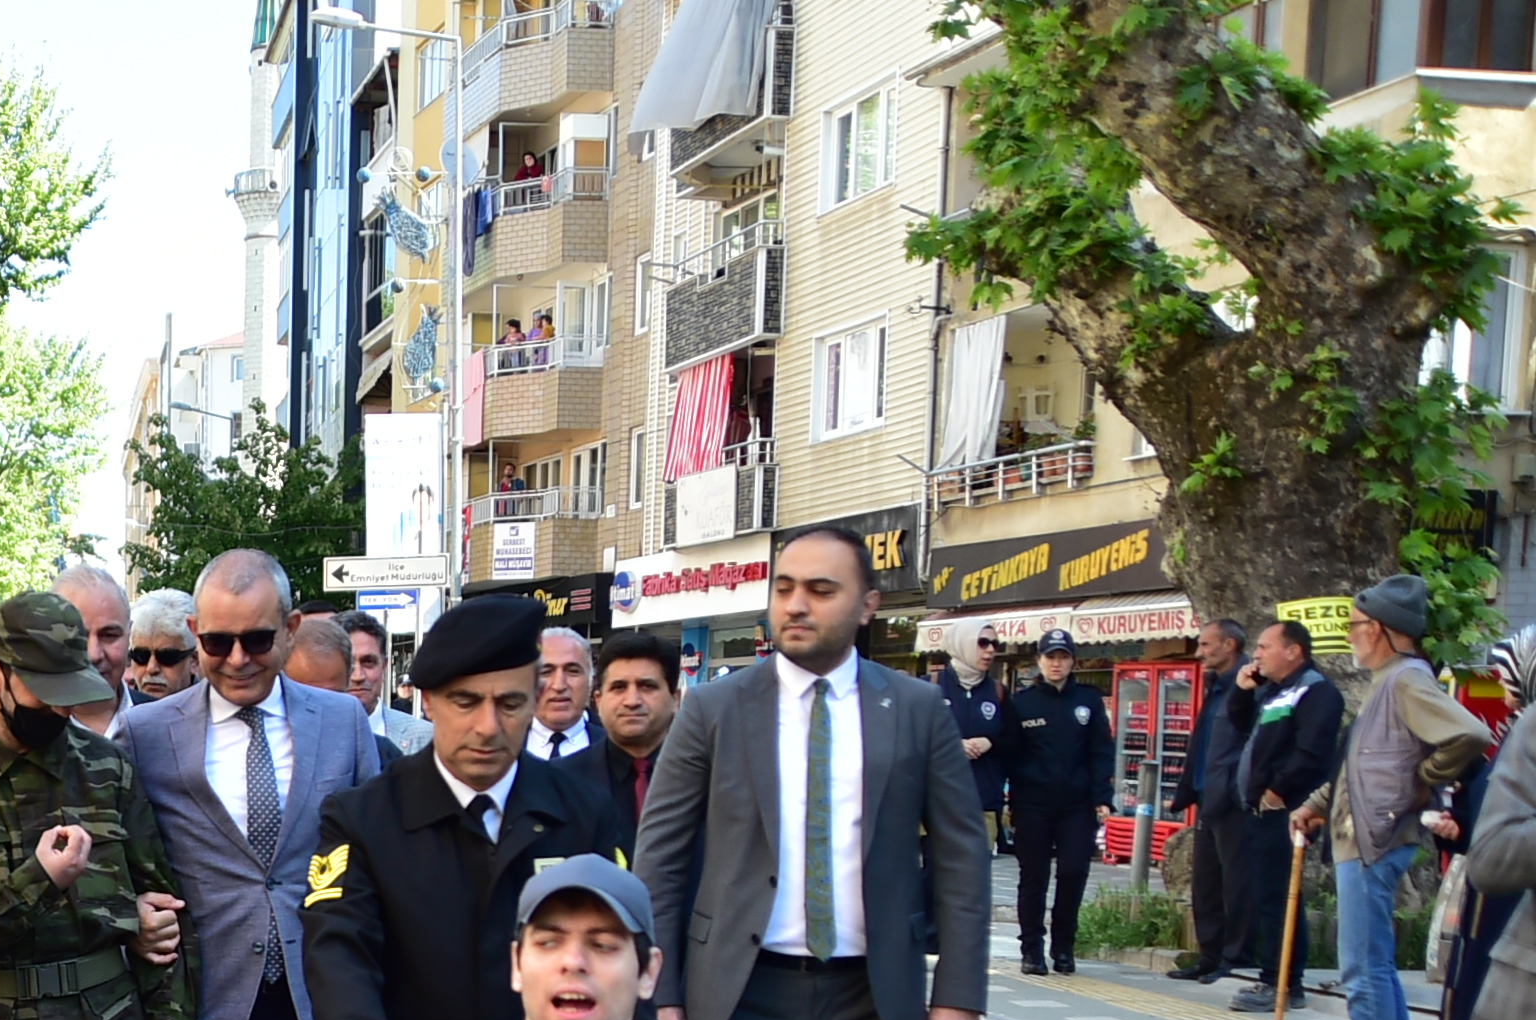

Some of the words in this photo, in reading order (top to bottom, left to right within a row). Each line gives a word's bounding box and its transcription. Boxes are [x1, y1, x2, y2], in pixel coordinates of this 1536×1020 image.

[388, 562, 406, 571] İlçe
[350, 574, 390, 583] Emniyet
[390, 571, 444, 582] Müdürlüğü
[1286, 604, 1350, 621] SEZG
[1097, 610, 1185, 636] KURUYEMİŞ
